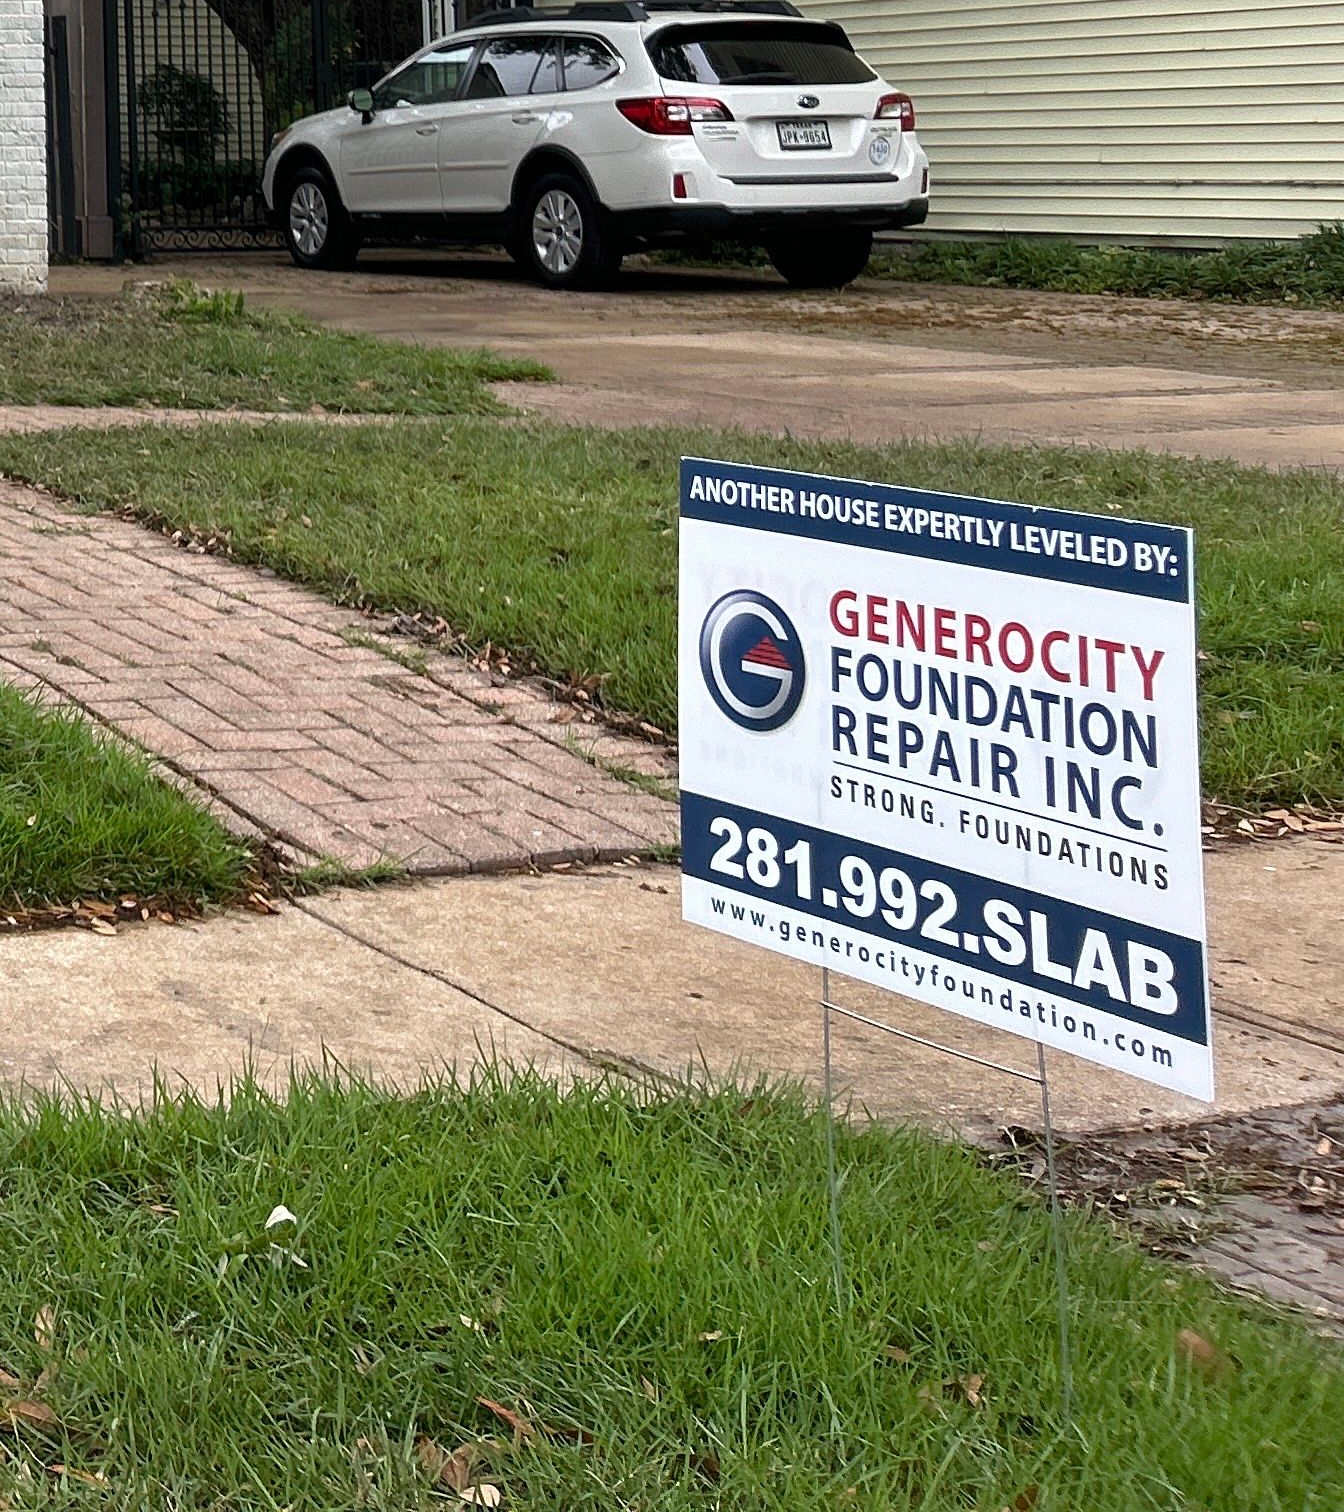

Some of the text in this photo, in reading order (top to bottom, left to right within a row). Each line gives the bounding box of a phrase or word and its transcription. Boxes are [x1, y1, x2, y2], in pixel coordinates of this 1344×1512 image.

[689, 475, 1178, 577] ANOTHER HOUSE EXPERTLY LEVELED BY:
[829, 590, 1165, 701] GENEROCITY
[831, 646, 1158, 769] FOUNDATION
[832, 704, 1164, 836] REPAIR INC.
[830, 775, 1168, 890] STRONG. FOUNDATIONS
[709, 816, 1179, 1016] 281.992.SLAB
[711, 897, 1173, 1067] www.generocityfoundation.com
